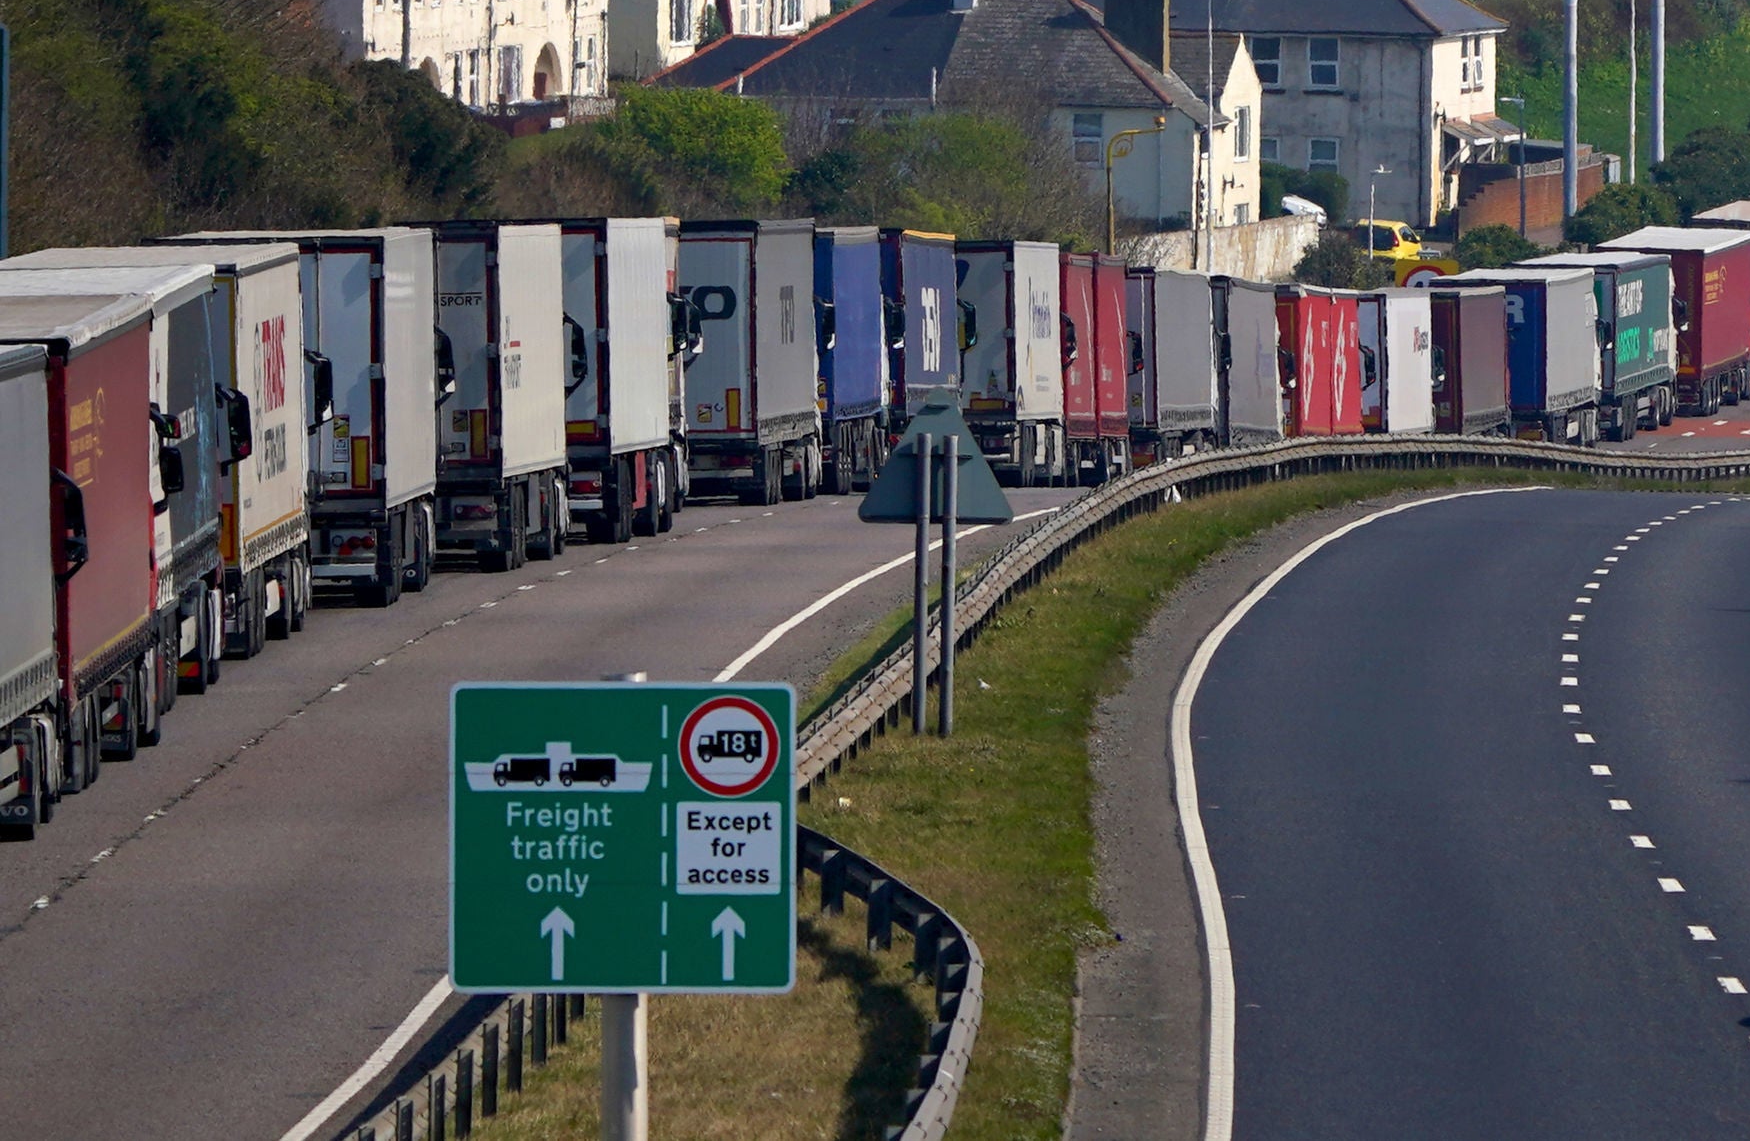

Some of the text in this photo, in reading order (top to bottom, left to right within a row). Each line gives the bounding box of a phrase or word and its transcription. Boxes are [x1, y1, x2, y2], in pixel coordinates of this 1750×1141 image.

[506, 802, 613, 832] Freight
[687, 811, 772, 835] Except
[511, 835, 605, 860] traffic
[711, 838, 746, 858] for
[526, 868, 590, 898] only
[687, 868, 770, 884] access
